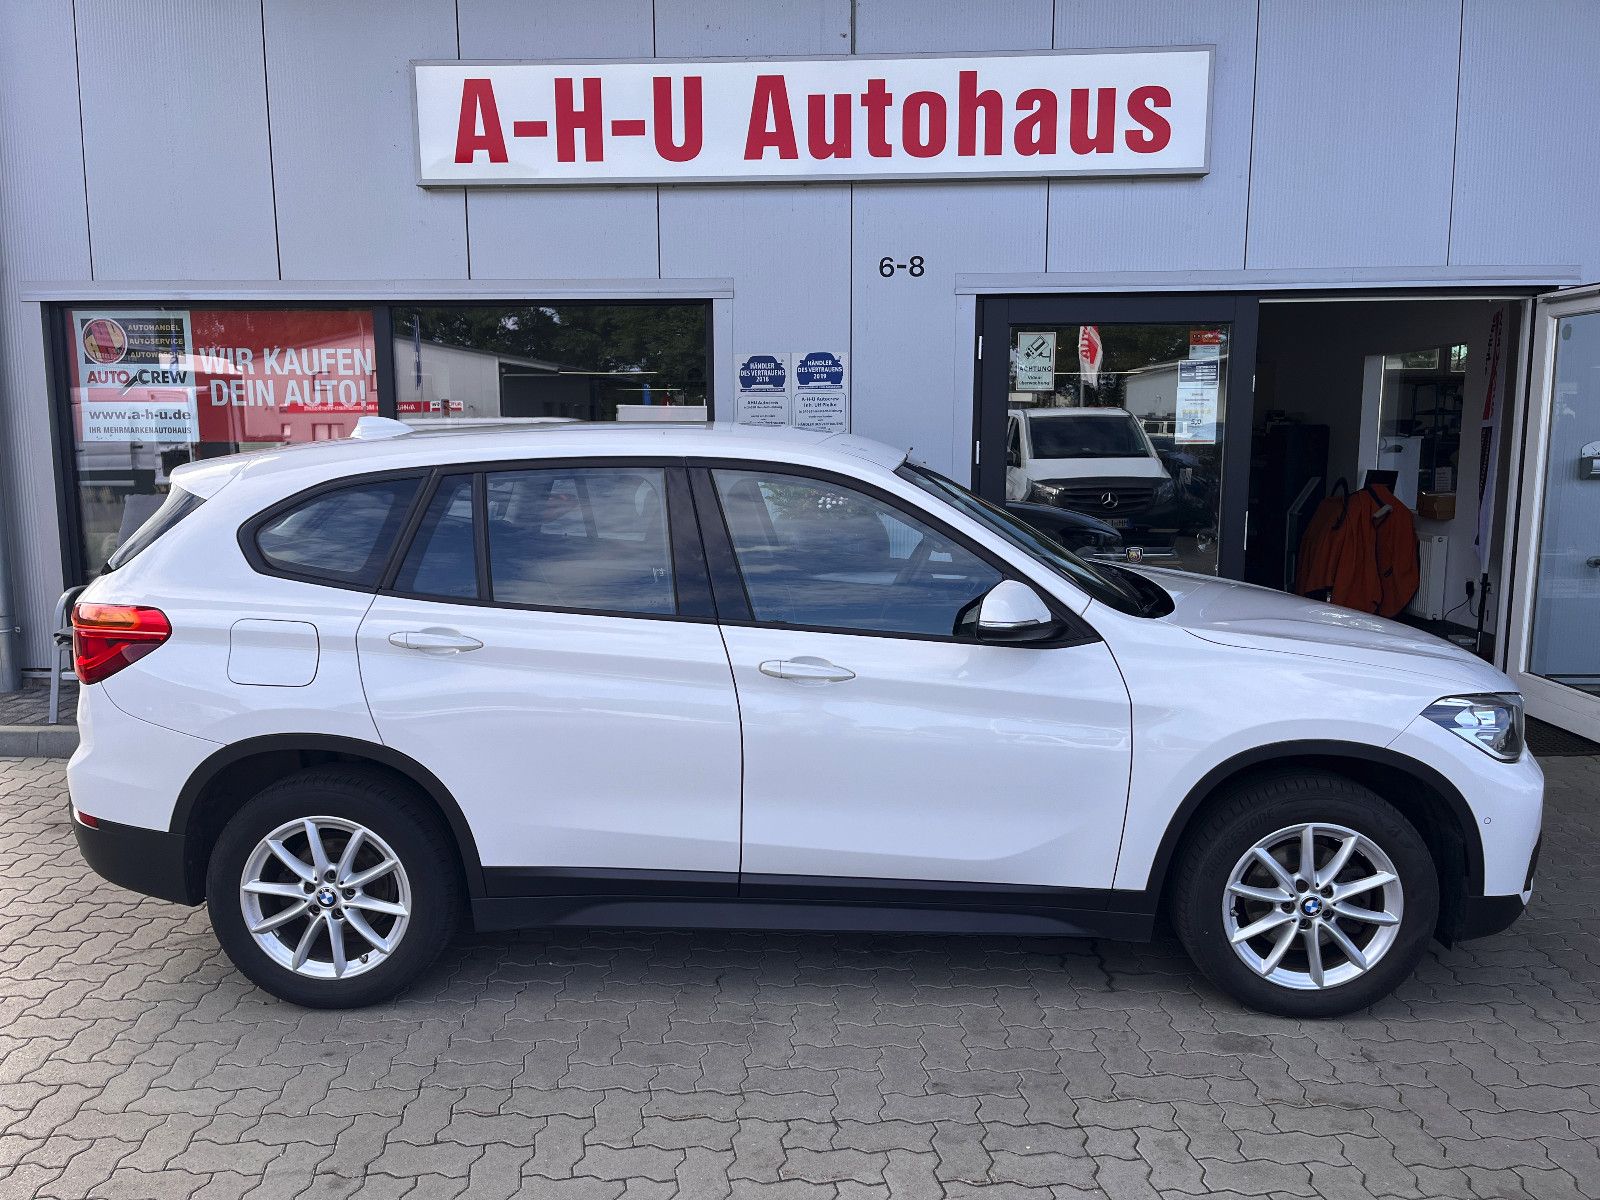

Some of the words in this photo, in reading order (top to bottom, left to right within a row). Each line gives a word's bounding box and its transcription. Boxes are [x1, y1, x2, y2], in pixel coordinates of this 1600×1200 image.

[454, 76, 703, 164] A-H-U
[744, 70, 1172, 160] Autohaus
[879, 255, 925, 278] 6-8
[127, 324, 181, 332] AUTOHANDEL
[199, 347, 255, 375] WIR
[264, 348, 373, 376] KAUFEN
[87, 370, 131, 384] AUTO
[138, 369, 187, 385] CREW
[209, 379, 275, 407] DEIN
[284, 379, 367, 408] AUTO!
[89, 409, 192, 420] www.a-h-u.de
[89, 426, 102, 434] IHR
[103, 426, 192, 434] MEHRMARKENAUTOHAUS
